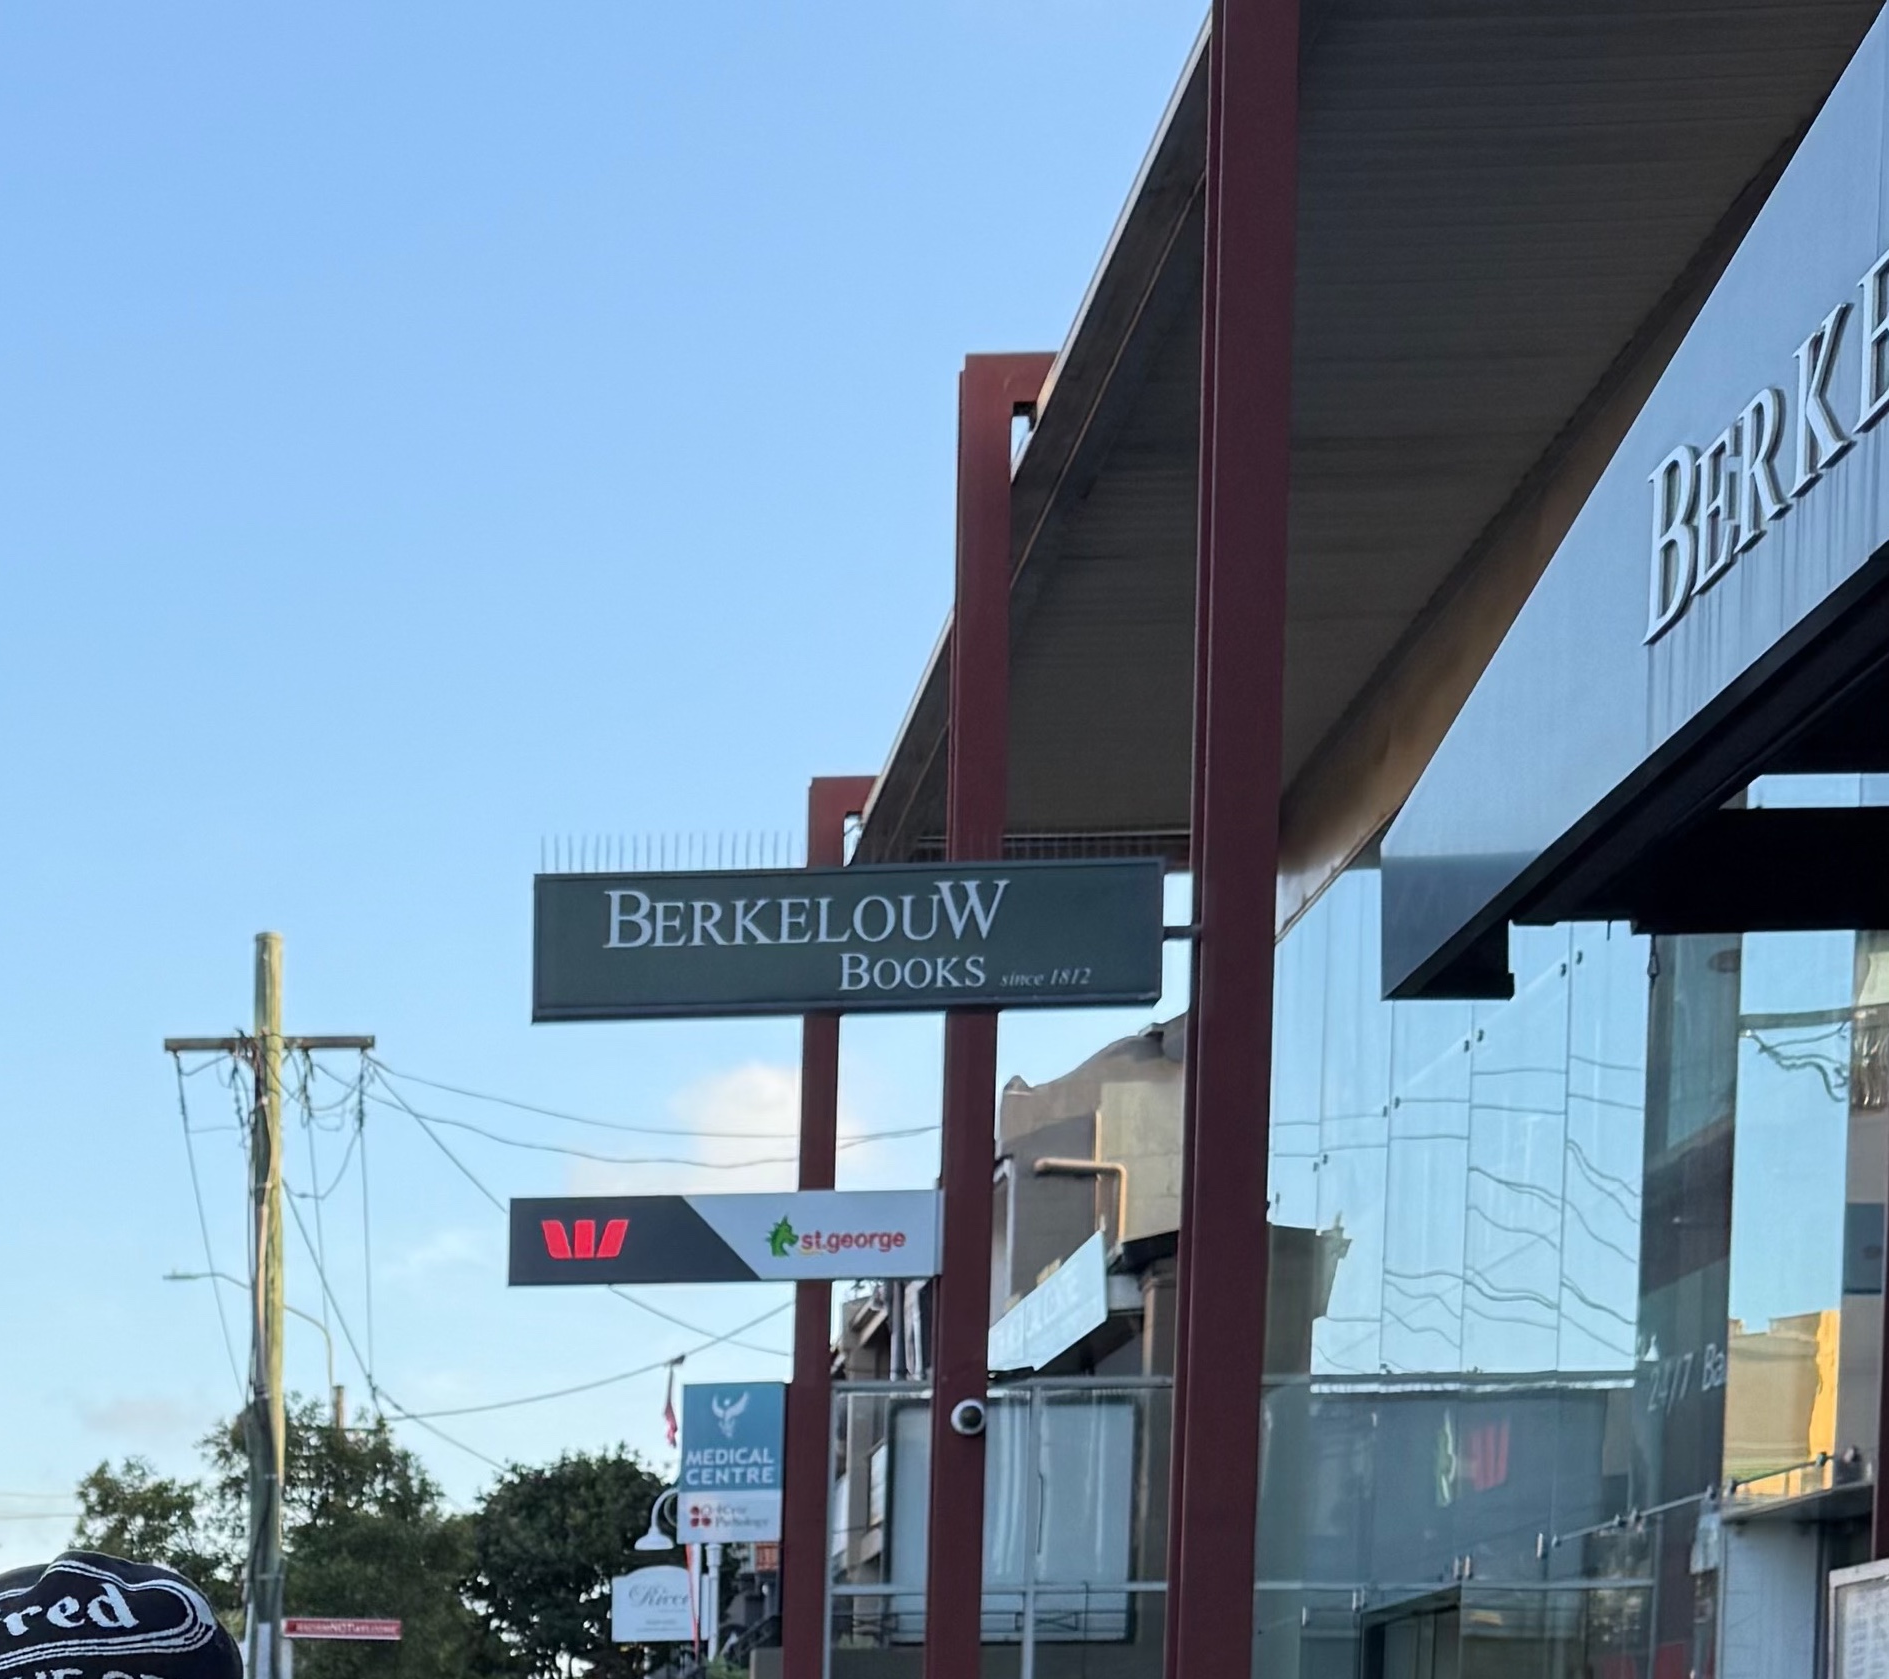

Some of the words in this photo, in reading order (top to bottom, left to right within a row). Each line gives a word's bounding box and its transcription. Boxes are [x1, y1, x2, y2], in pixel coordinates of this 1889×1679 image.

[603, 879, 1010, 949] BERKELOUW
[839, 952, 986, 991] BOOKS
[999, 970, 1045, 988] since
[1050, 967, 1092, 986] 1812
[800, 1228, 907, 1254] st.george
[686, 1448, 775, 1467] MEDICAL
[686, 1467, 775, 1486] CENTRE
